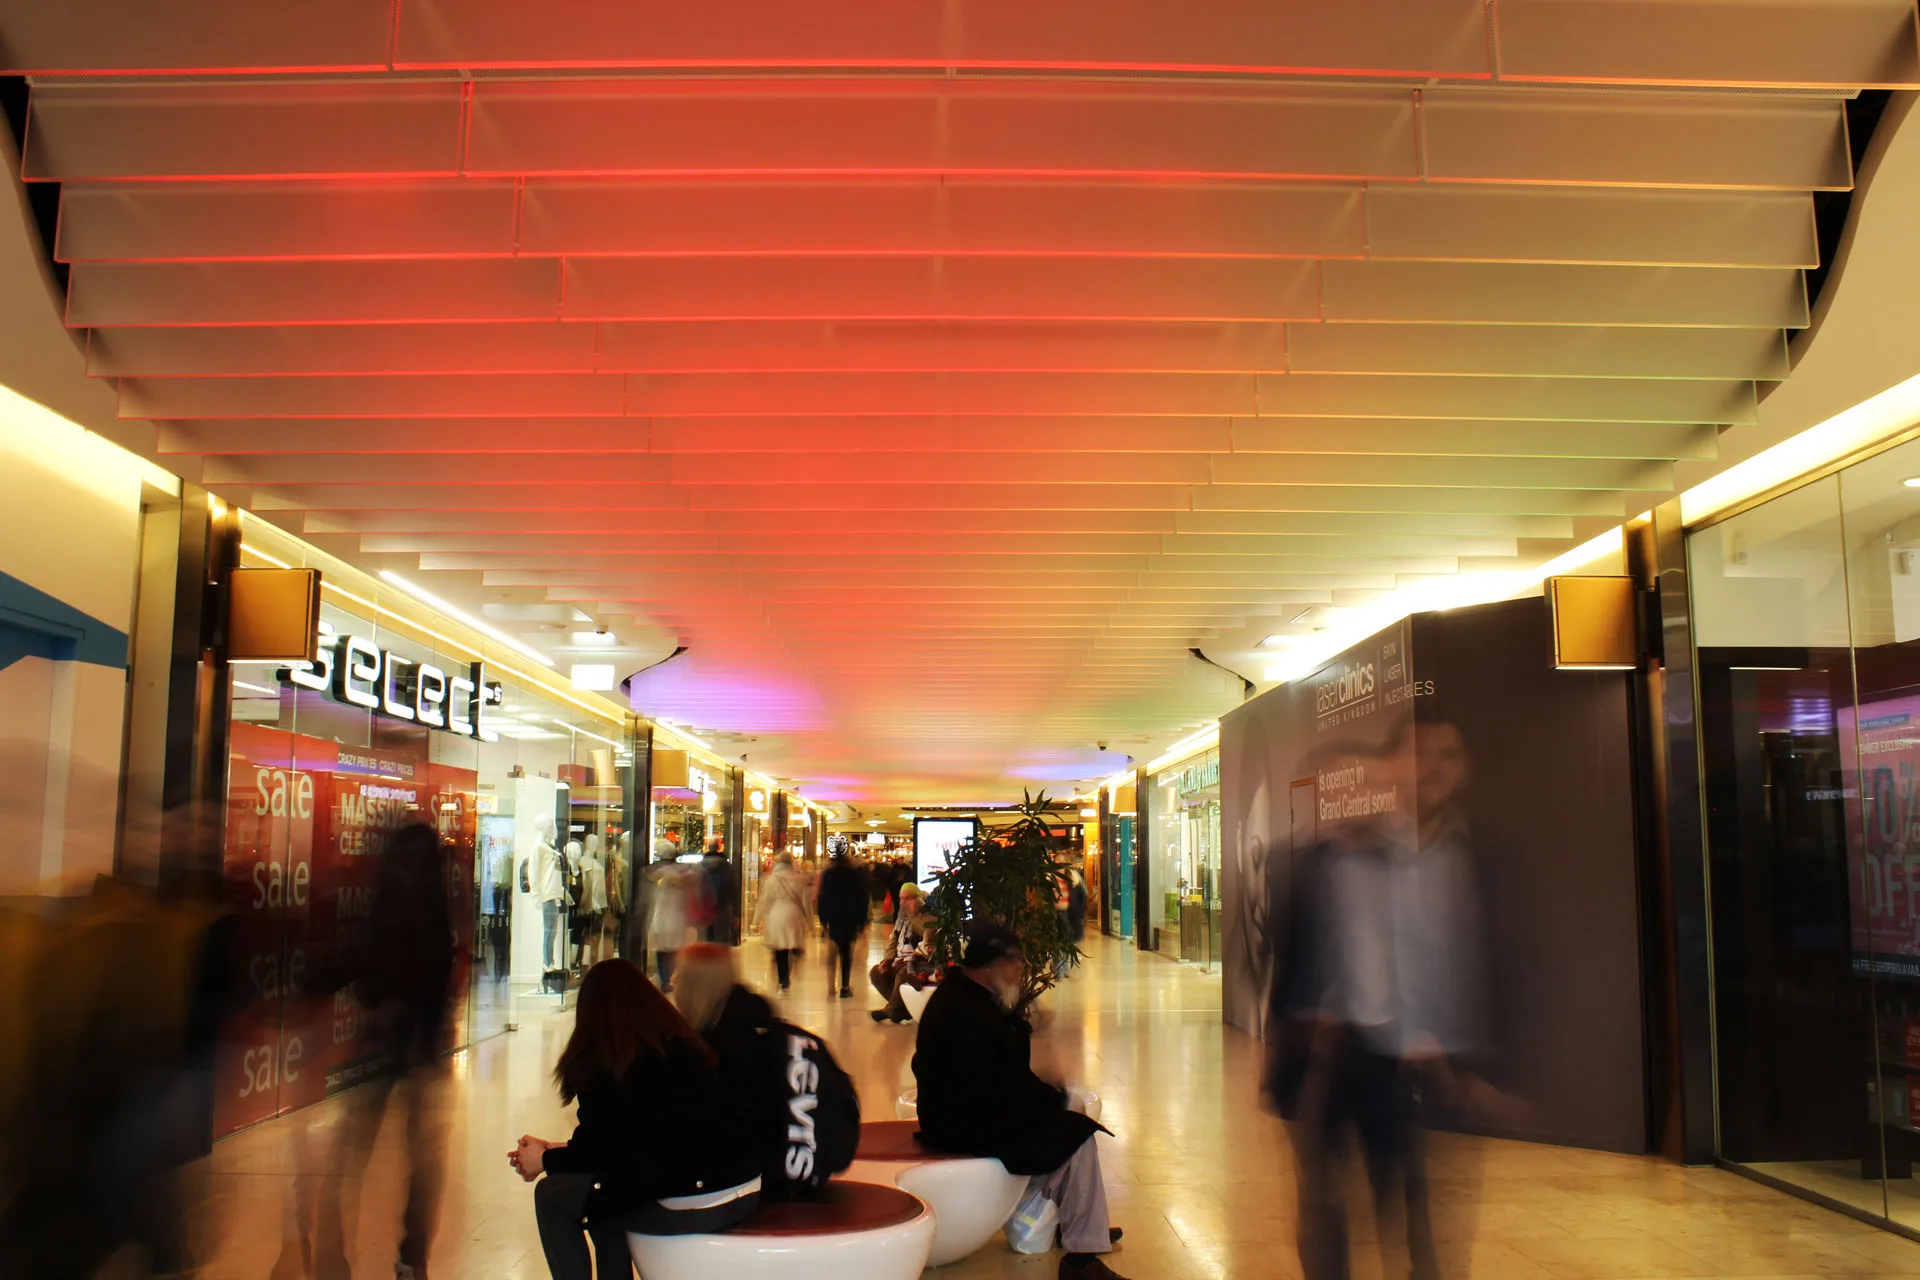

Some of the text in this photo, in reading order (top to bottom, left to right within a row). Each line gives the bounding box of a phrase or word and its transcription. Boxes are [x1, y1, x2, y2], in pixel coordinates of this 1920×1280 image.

[1383, 641, 1397, 659] SKIN
[1384, 663, 1402, 683] LASER
[1385, 680, 1435, 706] INJECTABLES
[1317, 701, 1376, 732] UNITED KINGDOM
[337, 752, 356, 766] CRAZY
[379, 760, 397, 772] CRAZY
[397, 762, 414, 776] PRICES
[1318, 759, 1365, 795] is opening in
[256, 756, 314, 819] sale
[1319, 784, 1397, 821] Grand Central soon!
[430, 784, 463, 832] sale
[252, 844, 310, 910] sale
[249, 936, 306, 1000] sale
[239, 1022, 303, 1098] sale
